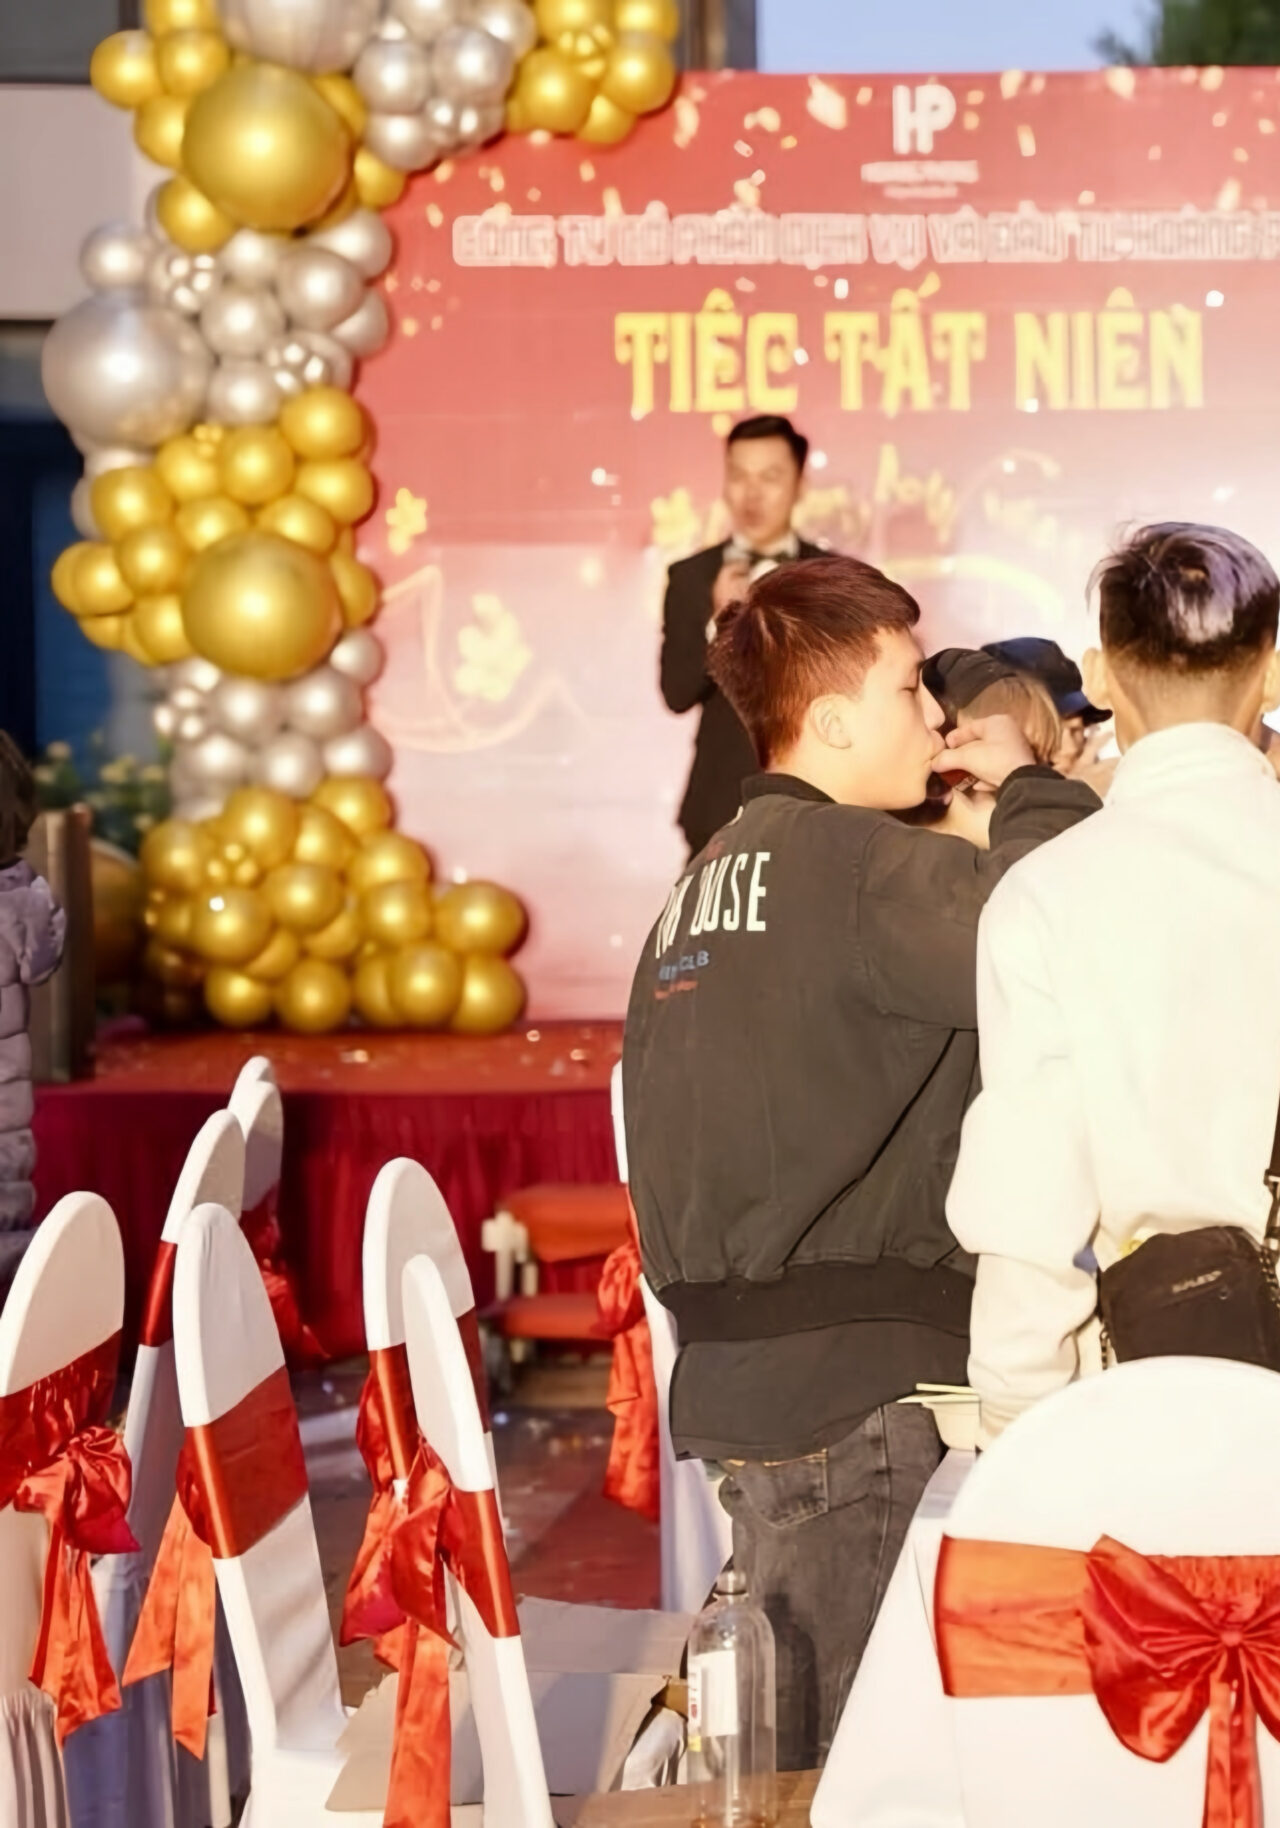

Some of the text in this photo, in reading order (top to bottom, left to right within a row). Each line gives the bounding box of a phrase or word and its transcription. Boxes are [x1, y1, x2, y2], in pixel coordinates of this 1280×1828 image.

[892, 84, 957, 155] HP
[615, 271, 1206, 433] TIỆC TẤT NIÊN
